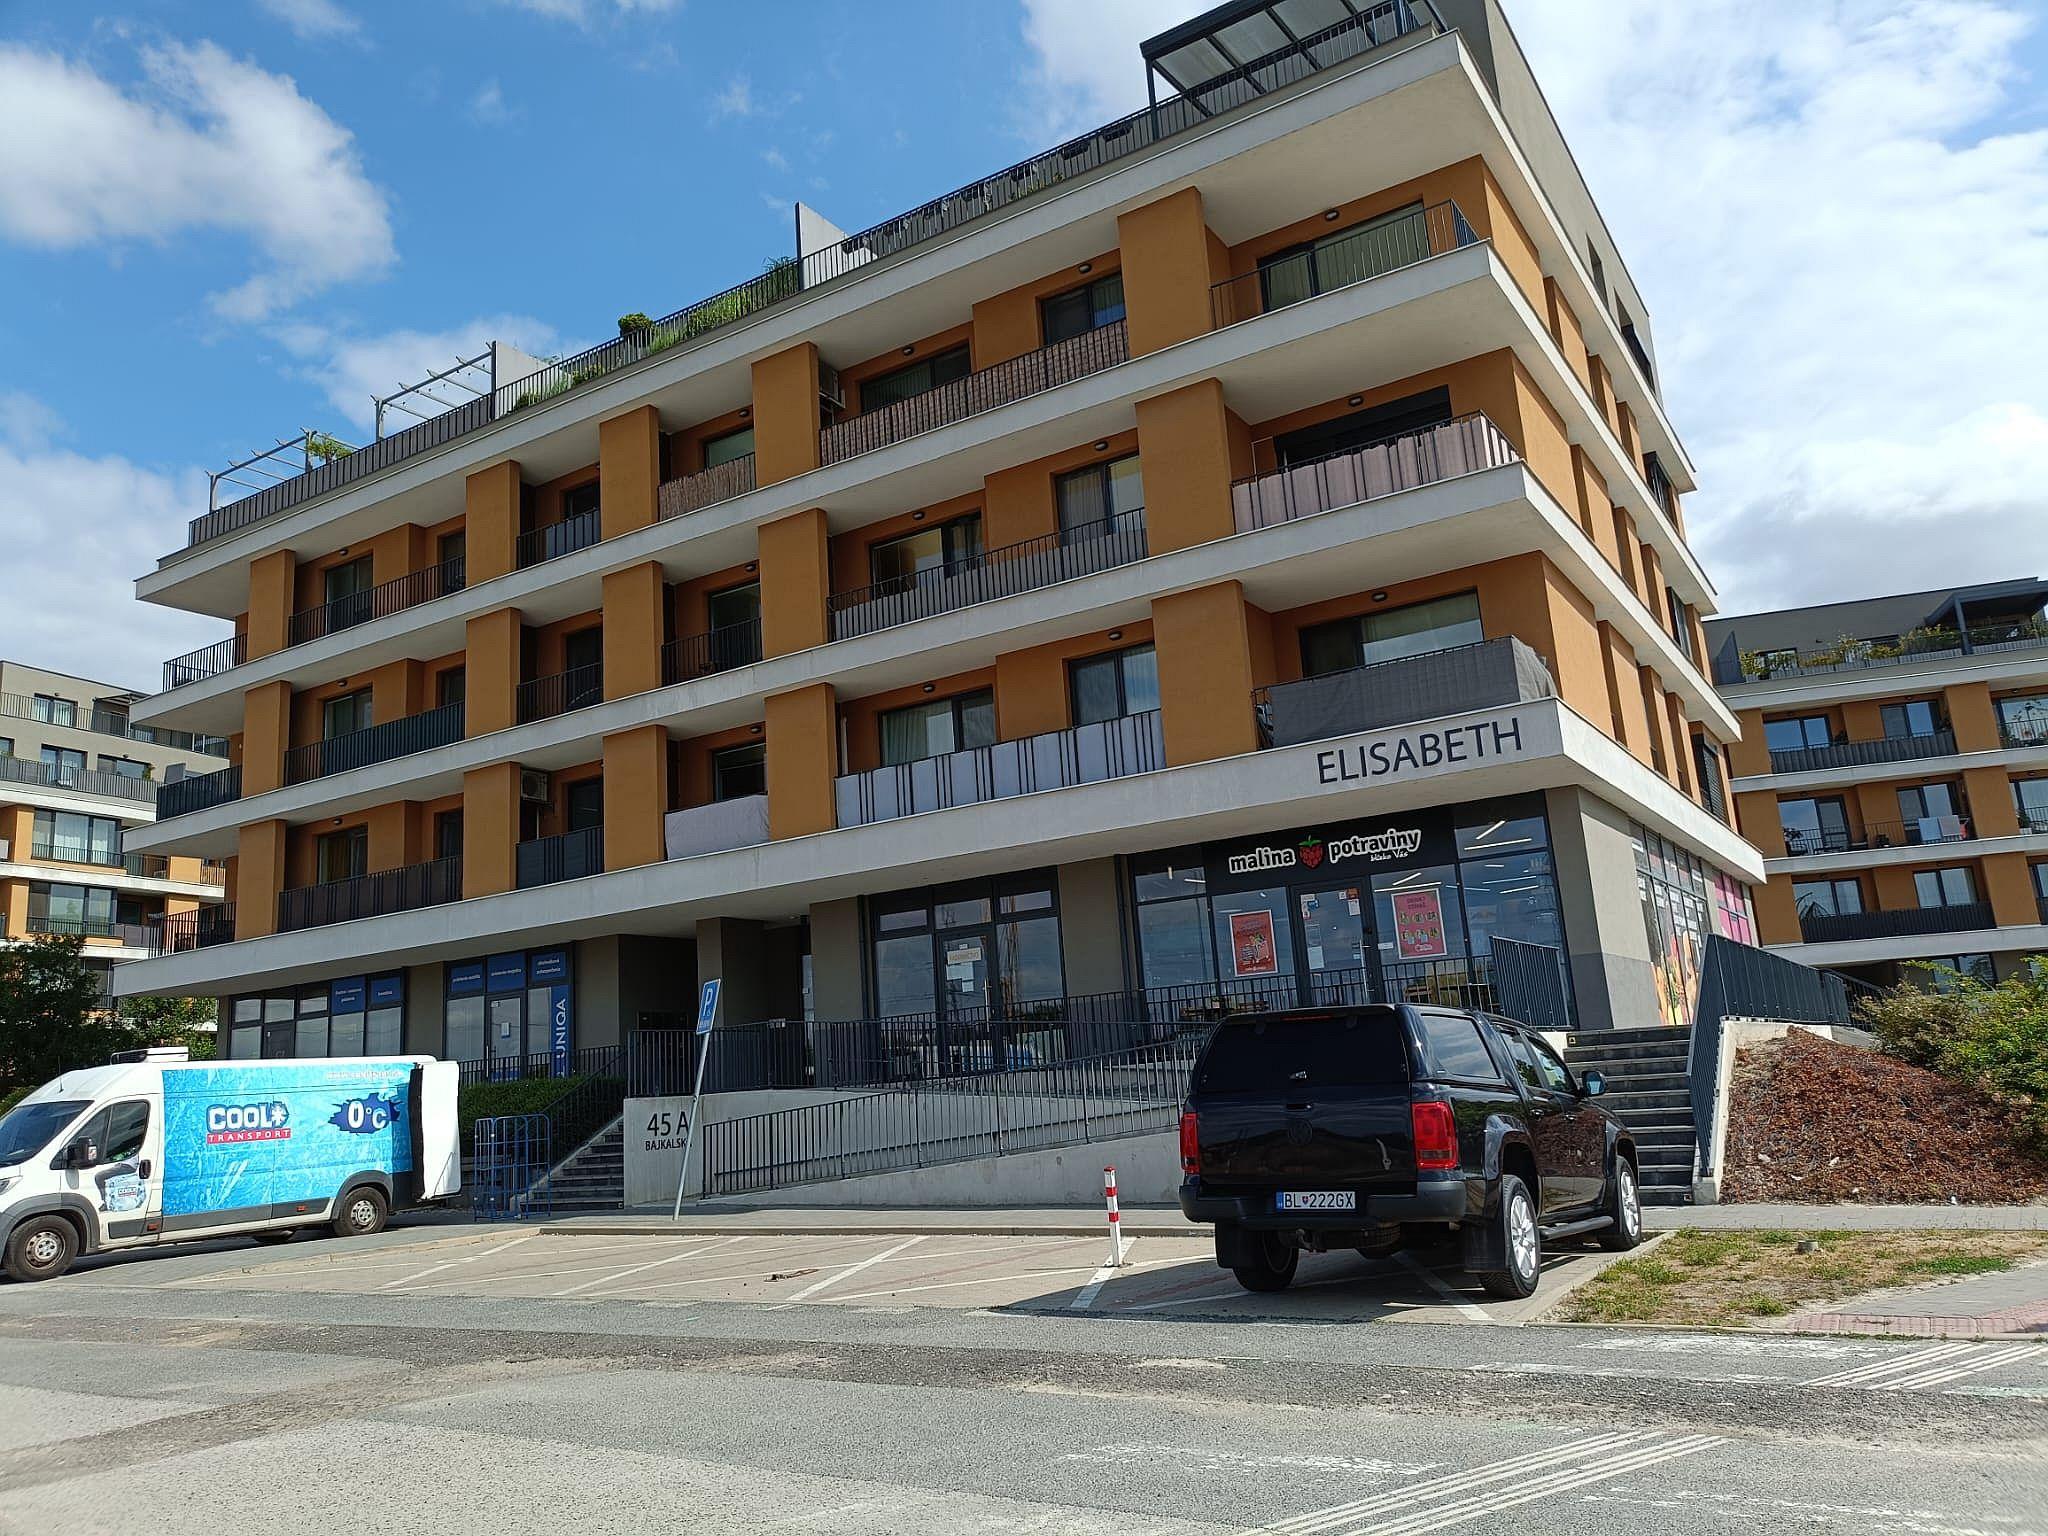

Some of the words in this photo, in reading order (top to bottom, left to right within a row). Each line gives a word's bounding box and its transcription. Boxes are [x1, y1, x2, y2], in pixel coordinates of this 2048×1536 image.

[1317, 717, 1522, 784] ELISABETH
[1229, 847, 1297, 874] malina
[1328, 828, 1422, 864] potraviny
[556, 998, 567, 1059] UNIQA
[208, 1102, 272, 1131] COOL
[646, 1112, 671, 1137] 45
[676, 1111, 689, 1136] A
[208, 1128, 290, 1143] TRANSPORT
[645, 1138, 693, 1152] BAJKALSK
